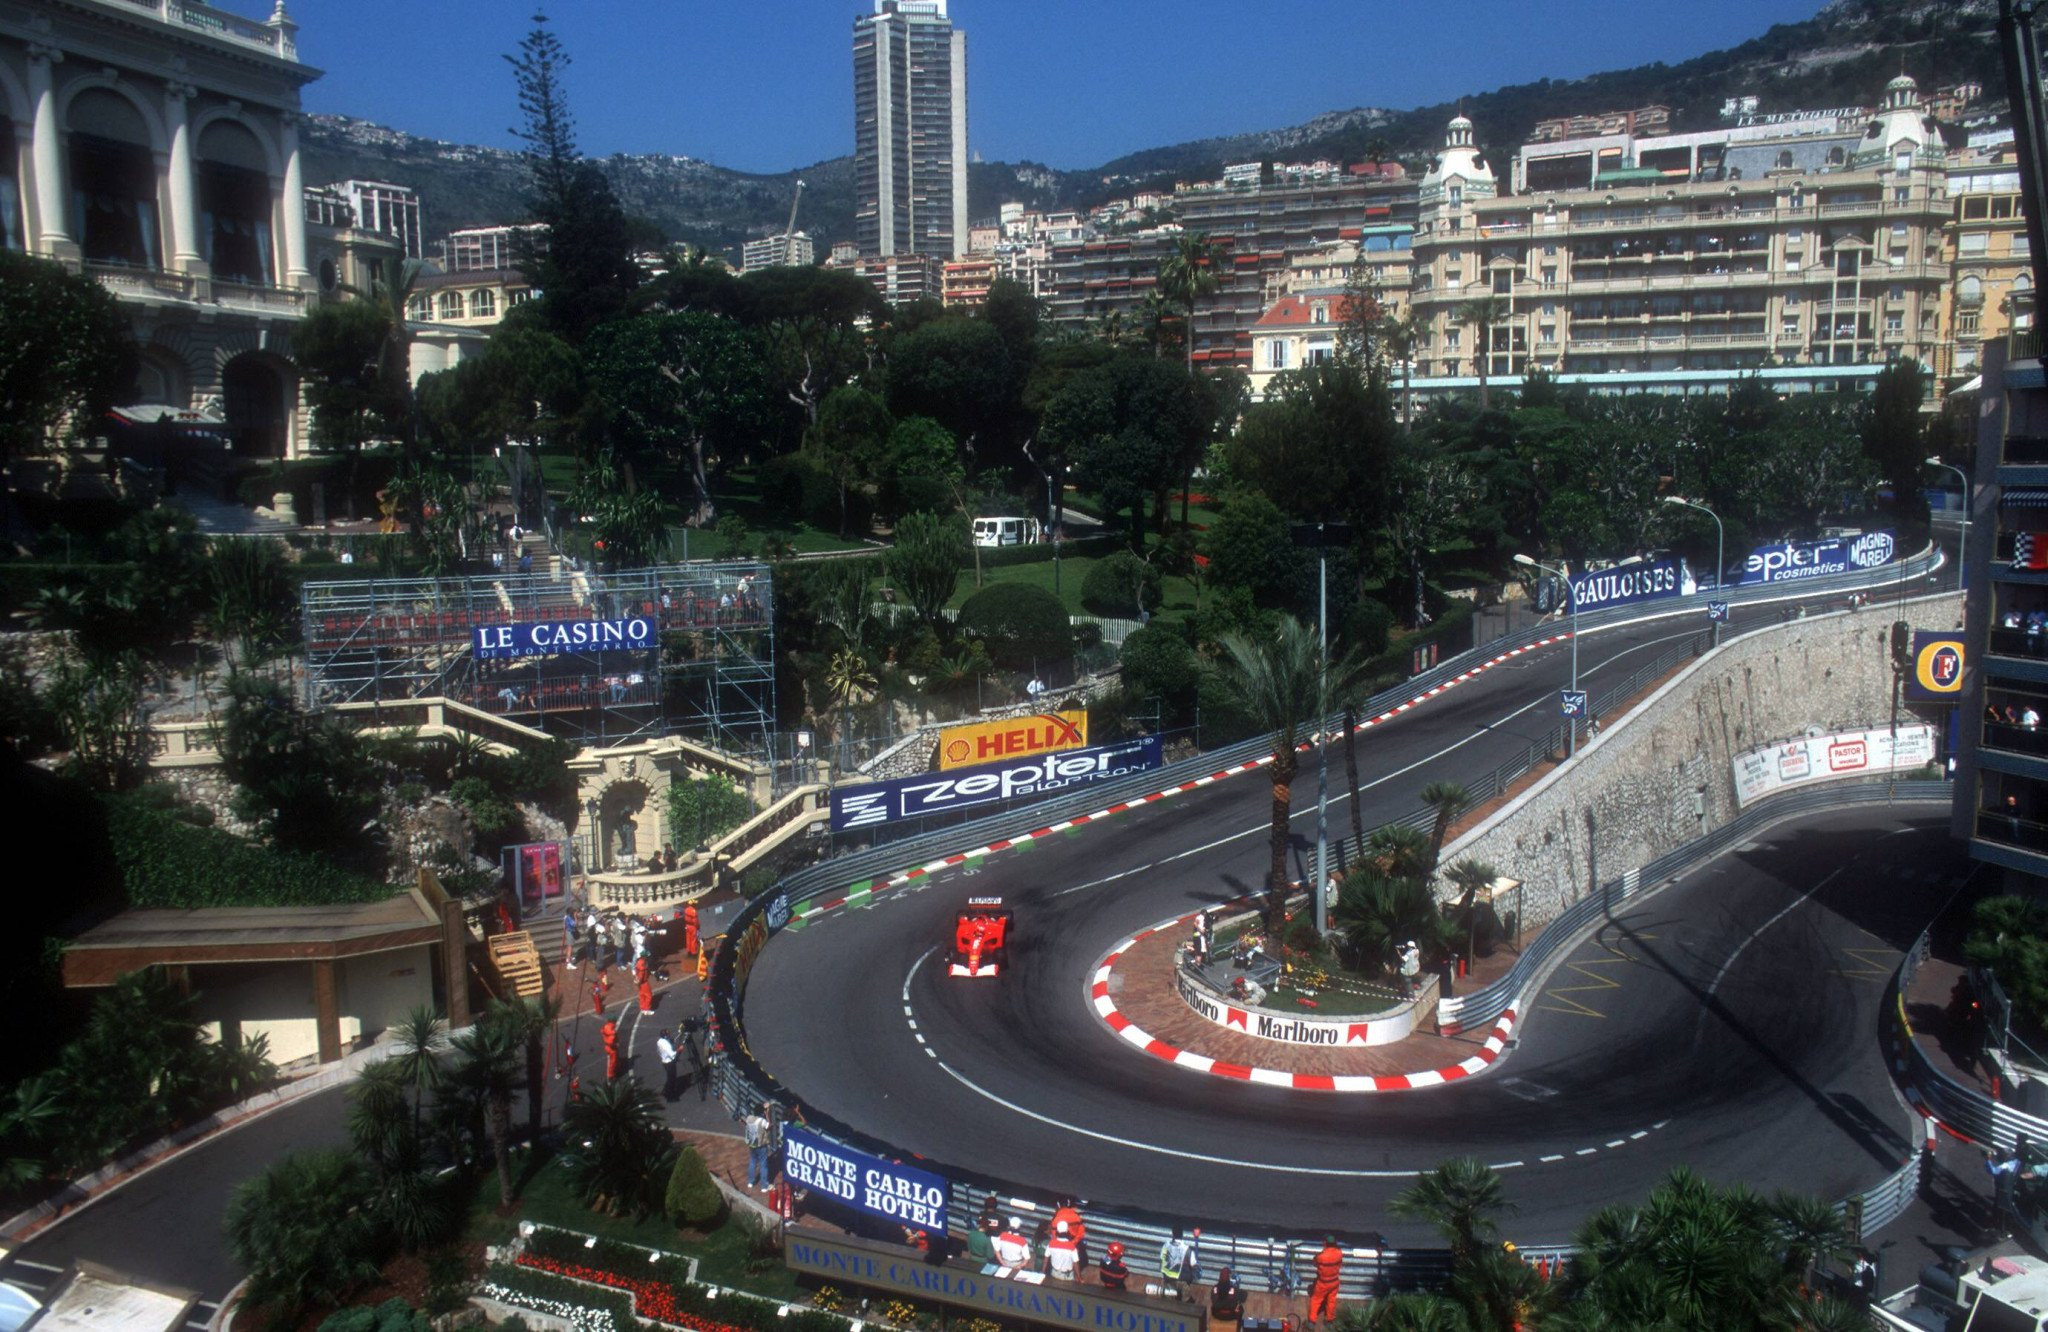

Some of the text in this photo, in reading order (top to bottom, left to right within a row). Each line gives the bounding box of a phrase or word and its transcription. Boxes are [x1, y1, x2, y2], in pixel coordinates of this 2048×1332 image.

[1575, 567, 1674, 605] GAULOISES
[1774, 562, 1844, 580] cosmetics
[479, 619, 648, 649] LE CASINO
[481, 649, 497, 659] DE
[1935, 655, 1956, 679] F
[977, 720, 1082, 759] HELIX
[1834, 747, 1861, 757] PASTOR
[905, 748, 1130, 806] zepter
[1257, 1015, 1338, 1044] Marlboro
[787, 1139, 943, 1209] MONTE CARLO
[786, 1159, 943, 1229] GRAND HOTEL
[793, 1244, 882, 1281] MONTE
[889, 1263, 977, 1299] CARLO
[986, 1283, 1085, 1320] GRAND
